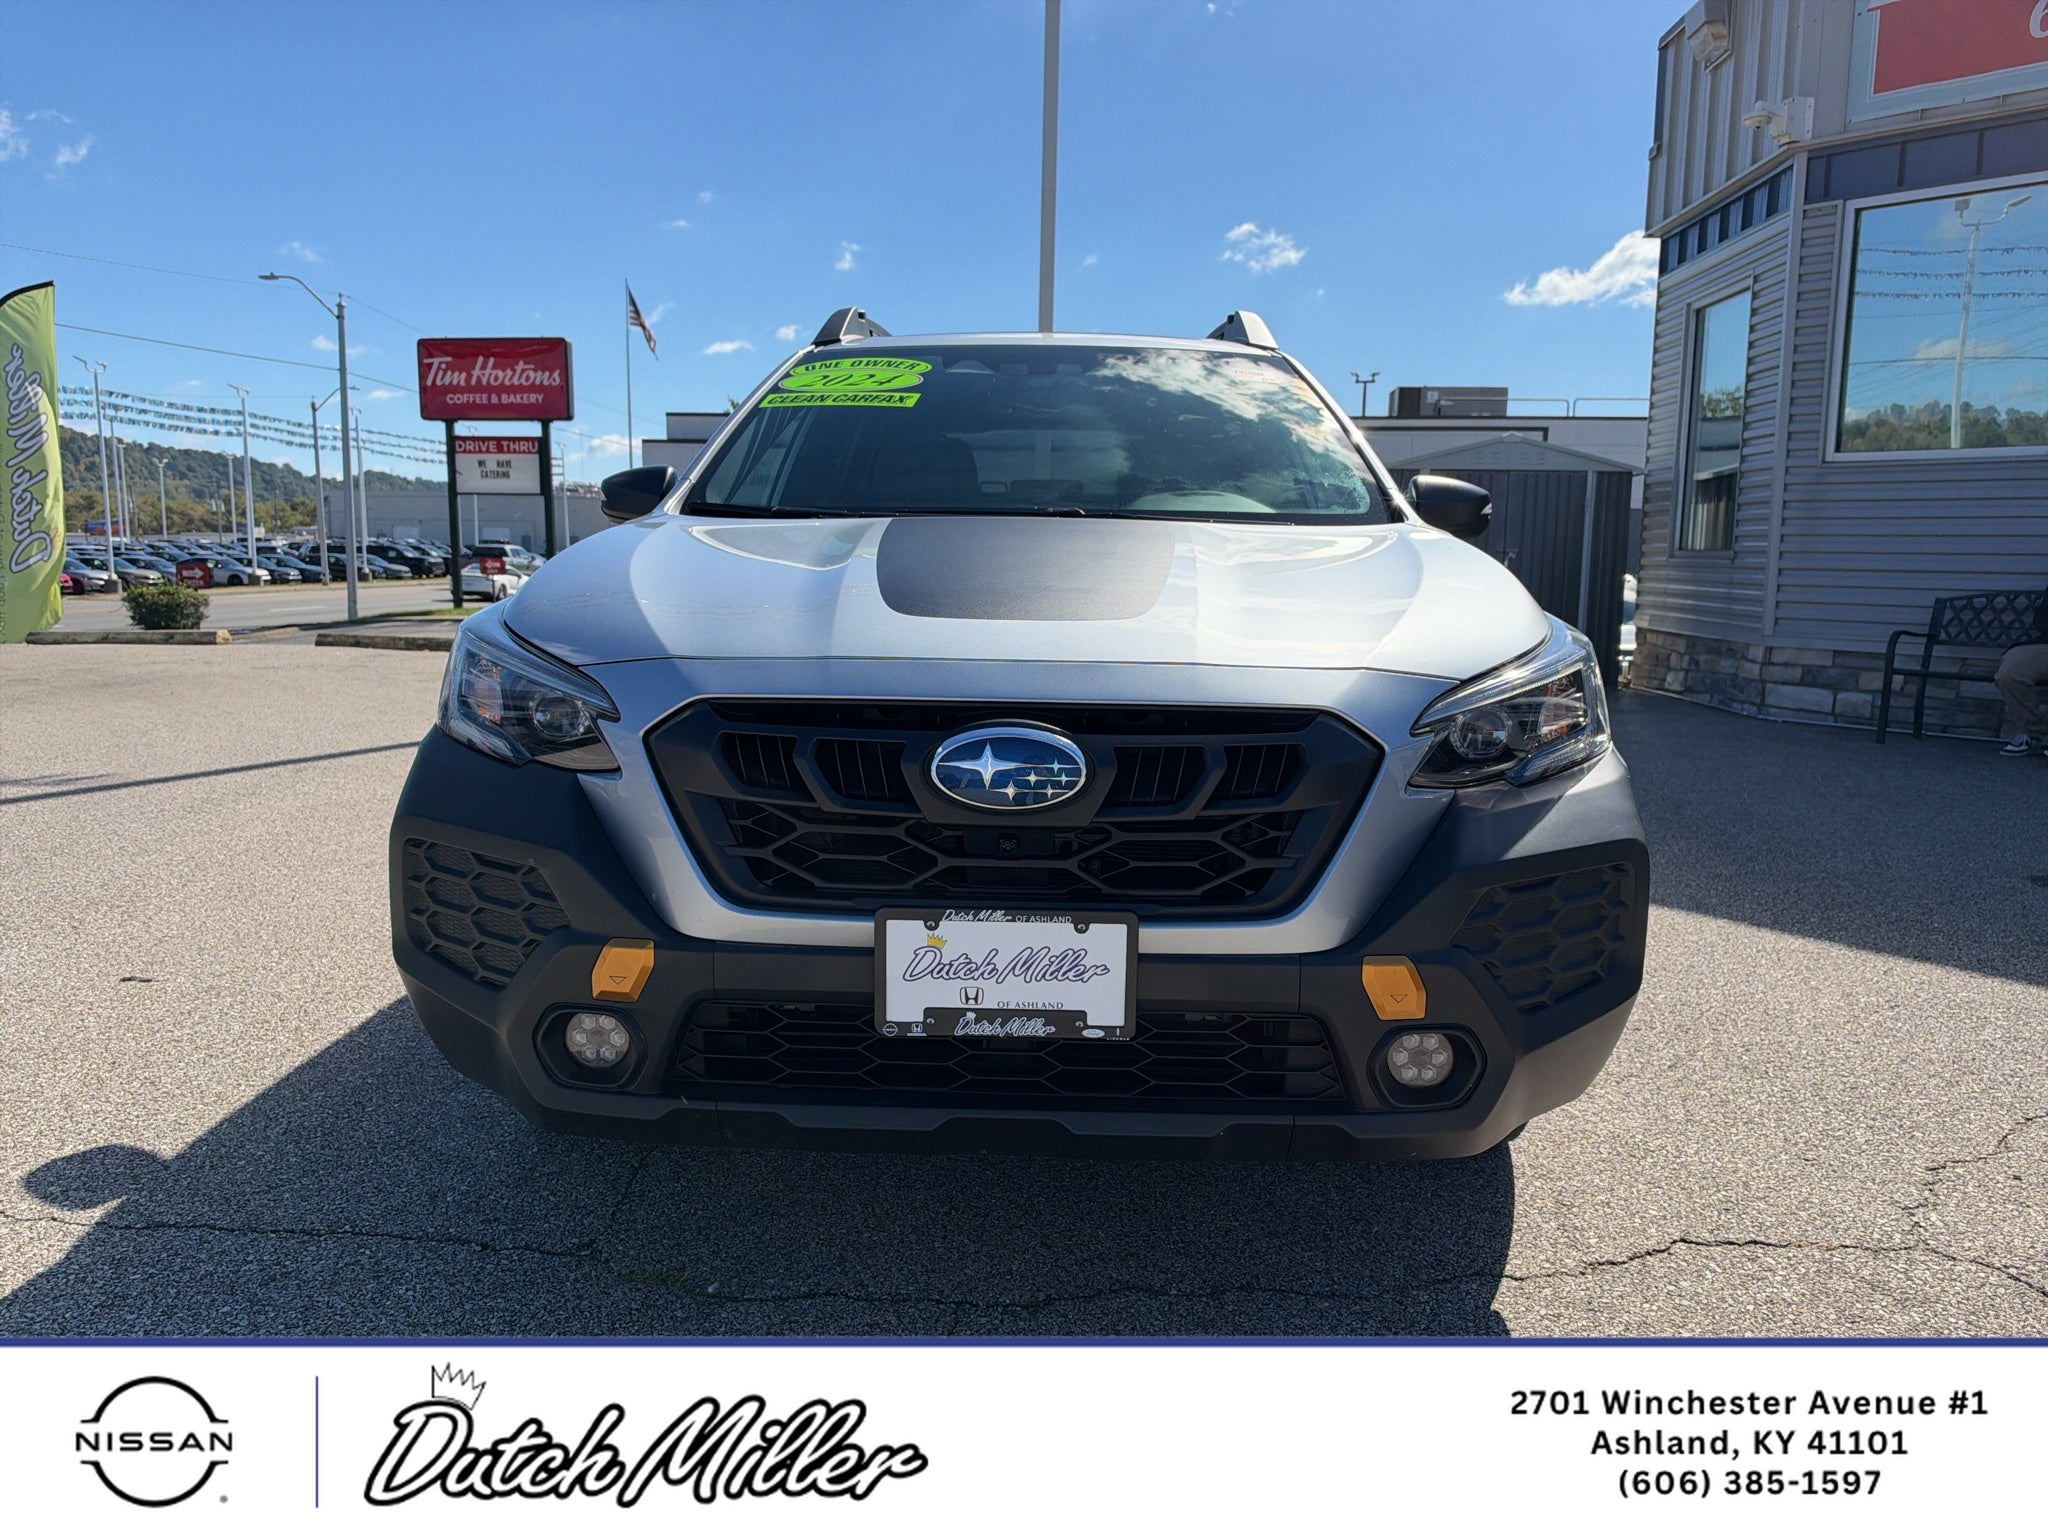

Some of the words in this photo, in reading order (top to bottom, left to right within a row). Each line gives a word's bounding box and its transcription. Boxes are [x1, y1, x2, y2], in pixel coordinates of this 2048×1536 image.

[423, 357, 466, 386] Tim
[471, 356, 561, 386] Hortons
[804, 361, 843, 372] ONE
[850, 360, 920, 370] OWNER
[796, 374, 906, 388] 2024
[446, 394, 488, 404] COFFEE
[491, 394, 499, 403] &
[501, 394, 544, 403] BAKERY
[767, 395, 831, 405] CLEAN
[831, 394, 914, 404] CARFAX
[456, 441, 497, 452] DRIVE
[503, 441, 538, 452] THRU
[478, 460, 486, 468] WE
[496, 460, 512, 469] HAVE
[480, 470, 510, 479] CATERING
[942, 910, 975, 922] Dutch
[975, 910, 1012, 922] Miller
[903, 946, 999, 981] Dutch
[997, 946, 1110, 984] Miller
[997, 1000, 1012, 1009] OF
[1014, 1001, 1063, 1009] ASHLAND
[954, 1017, 1000, 1035] Dutch
[999, 1017, 1056, 1037] Miller
